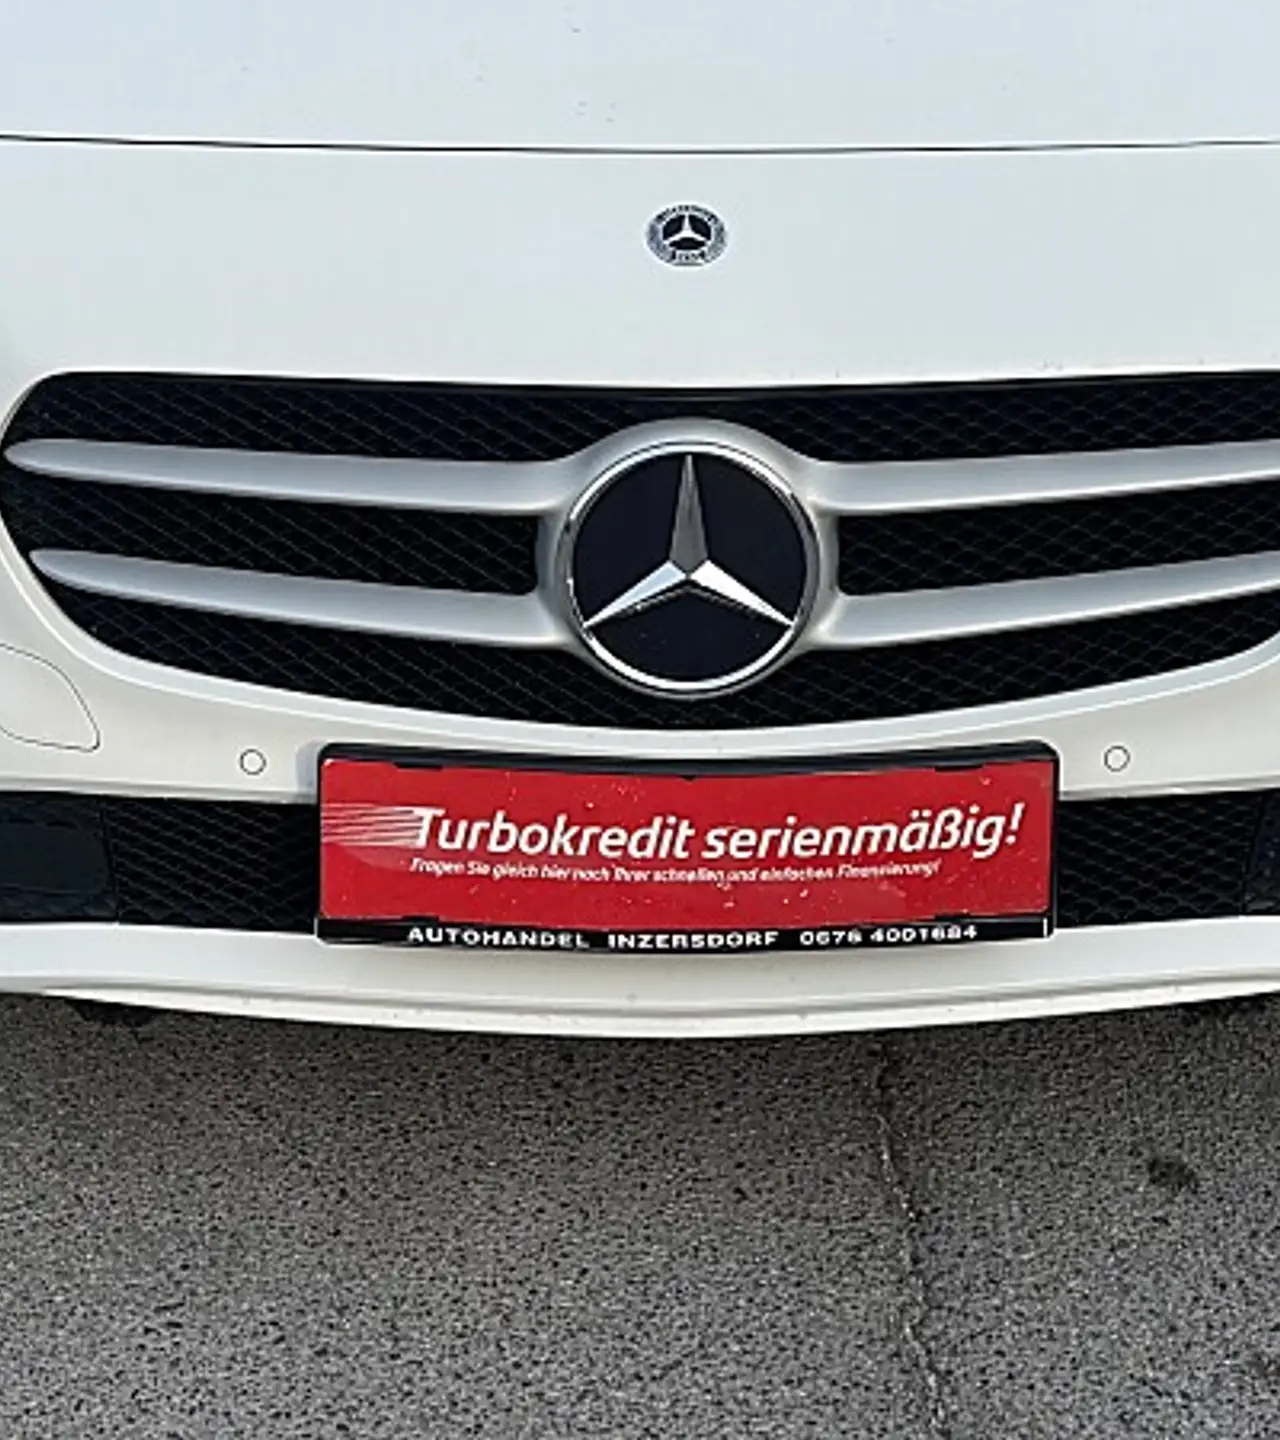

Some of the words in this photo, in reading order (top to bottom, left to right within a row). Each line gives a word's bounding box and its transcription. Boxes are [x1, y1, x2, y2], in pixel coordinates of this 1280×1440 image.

[412, 806, 695, 859] Turbokredit
[701, 802, 1025, 859] serienmäßig!
[407, 926, 590, 949] AUTOHANDEL
[607, 929, 780, 950] INZERSDORF
